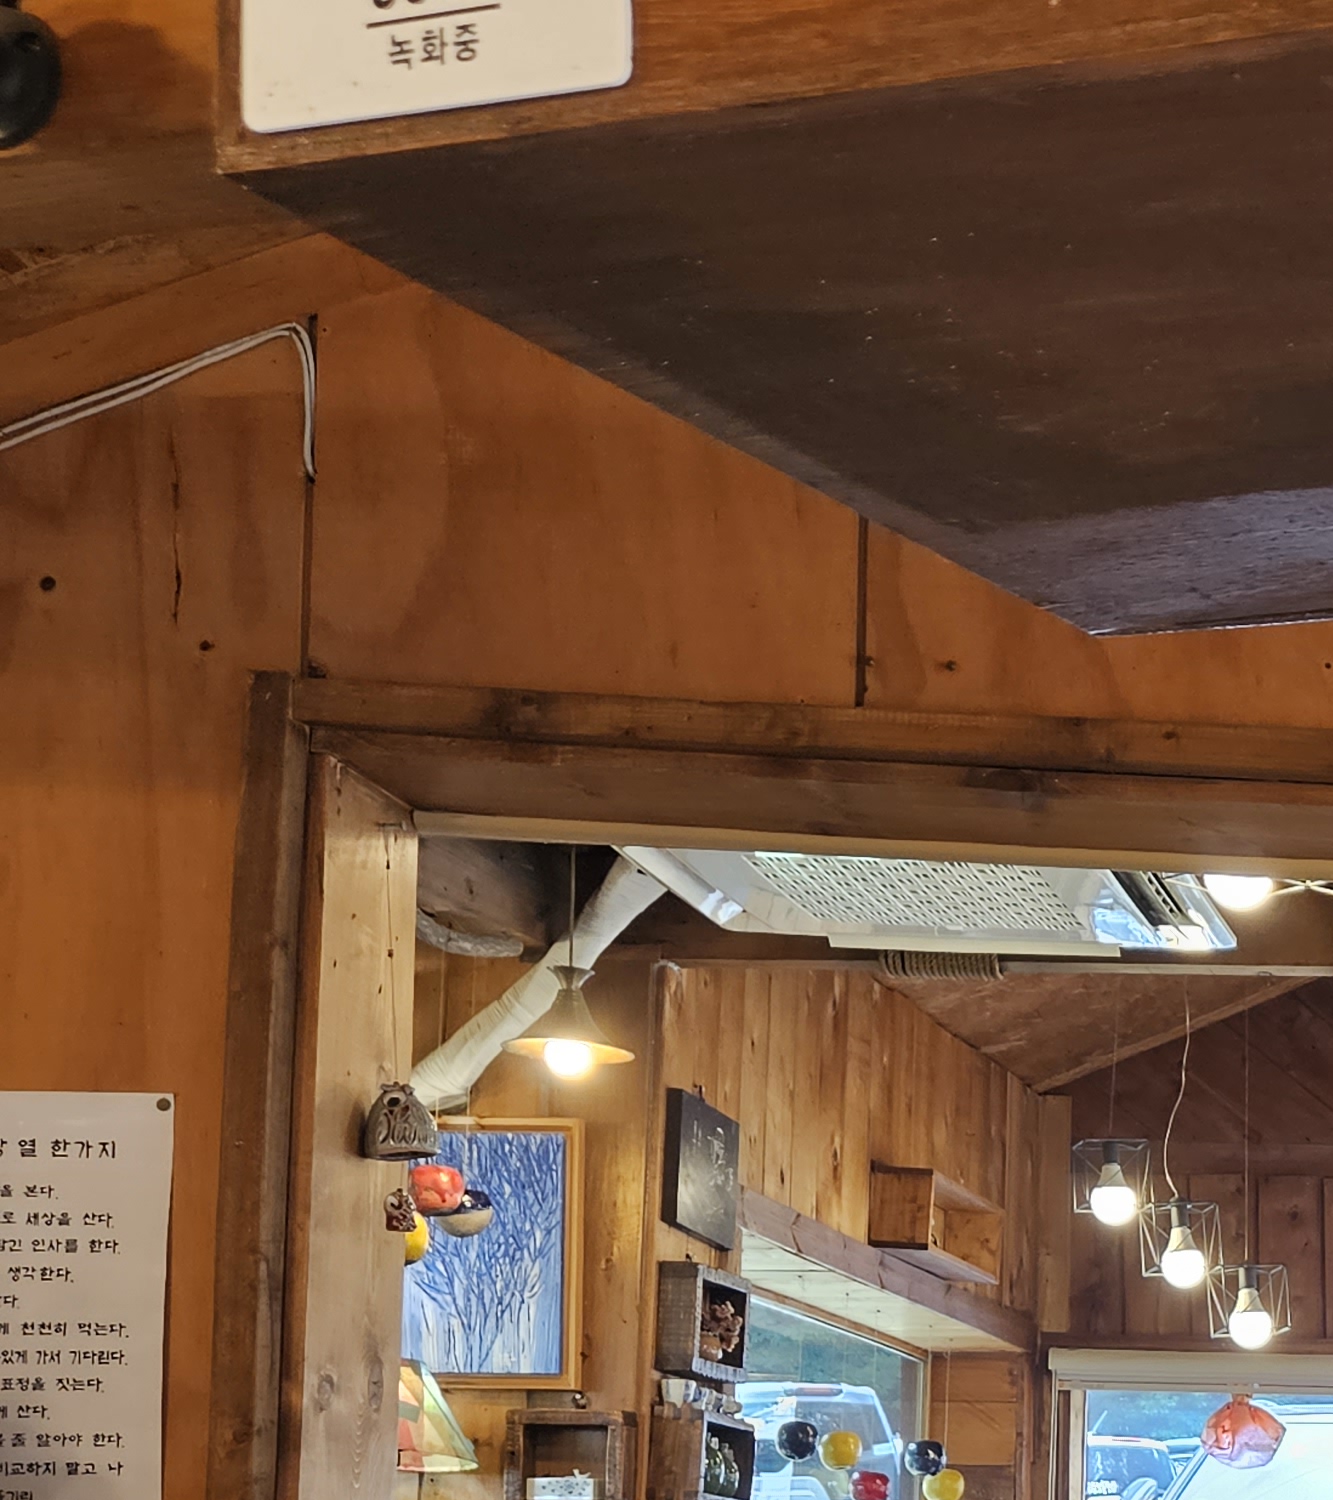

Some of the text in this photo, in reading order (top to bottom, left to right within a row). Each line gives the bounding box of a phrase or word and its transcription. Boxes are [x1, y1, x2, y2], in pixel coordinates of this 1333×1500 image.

[388, 24, 479, 70] 녹화중
[18, 1139, 37, 1158] 열
[50, 1139, 116, 1159] 한가지
[25, 1212, 72, 1226] 세상을
[31, 1238, 78, 1253] 인사를
[88, 1238, 120, 1255] 한다.
[0, 1294, 20, 1309] 다.
[21, 1322, 67, 1337] 천천히
[78, 1322, 129, 1338] 먹는다.
[0, 1350, 128, 1366] 있게 가서 기다린다.
[1, 1377, 105, 1393] 표정을 짓는다.
[16, 1405, 50, 1420] 산다.
[36, 1433, 83, 1448] 알아야
[92, 1433, 125, 1449] 한다.
[66, 1461, 97, 1476] 말고
[108, 1462, 124, 1476] 나
